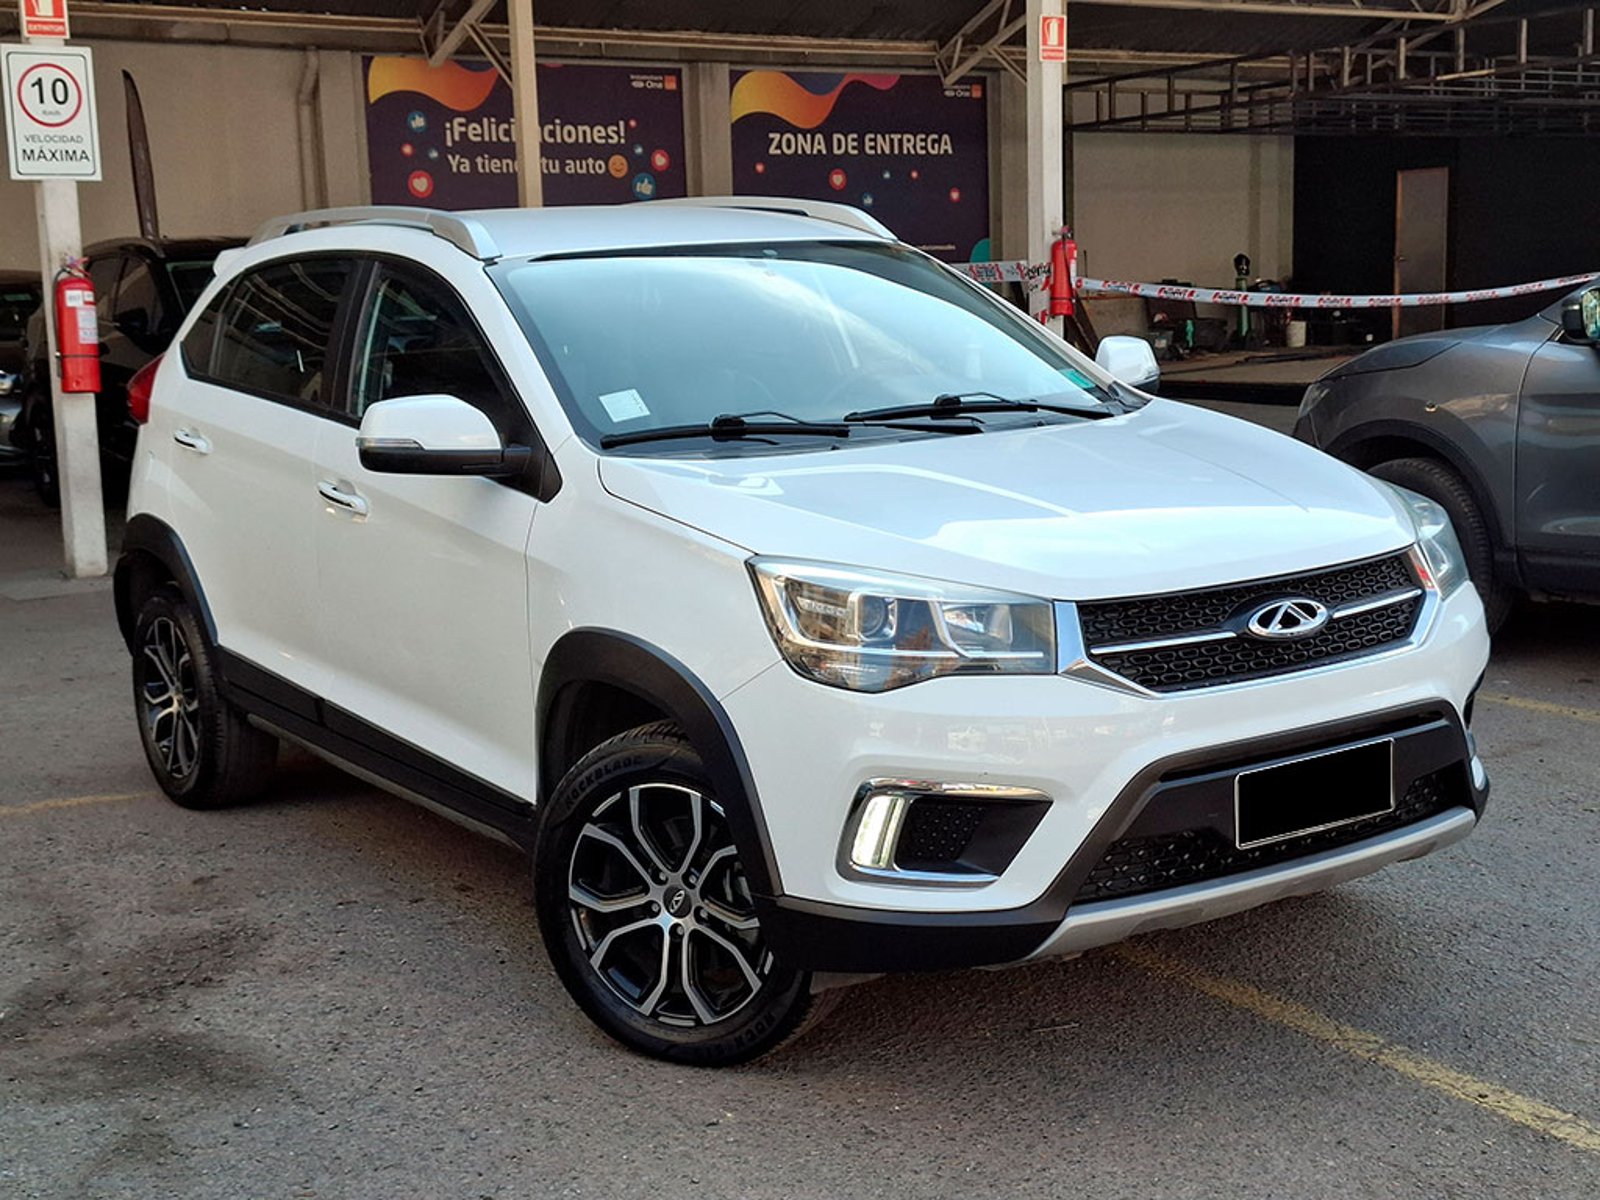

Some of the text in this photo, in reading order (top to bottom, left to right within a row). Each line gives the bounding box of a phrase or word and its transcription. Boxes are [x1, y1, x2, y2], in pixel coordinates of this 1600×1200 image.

[31, 77, 69, 105] 10
[24, 135, 84, 144] VELOCIDAD
[444, 117, 626, 147] ¡Feliciciones!
[22, 146, 91, 162] MÁXIMA
[768, 132, 953, 155] ZONA DE ENTREGA
[447, 154, 471, 173] Ya
[541, 157, 560, 174] tu
[565, 157, 606, 174] auto
